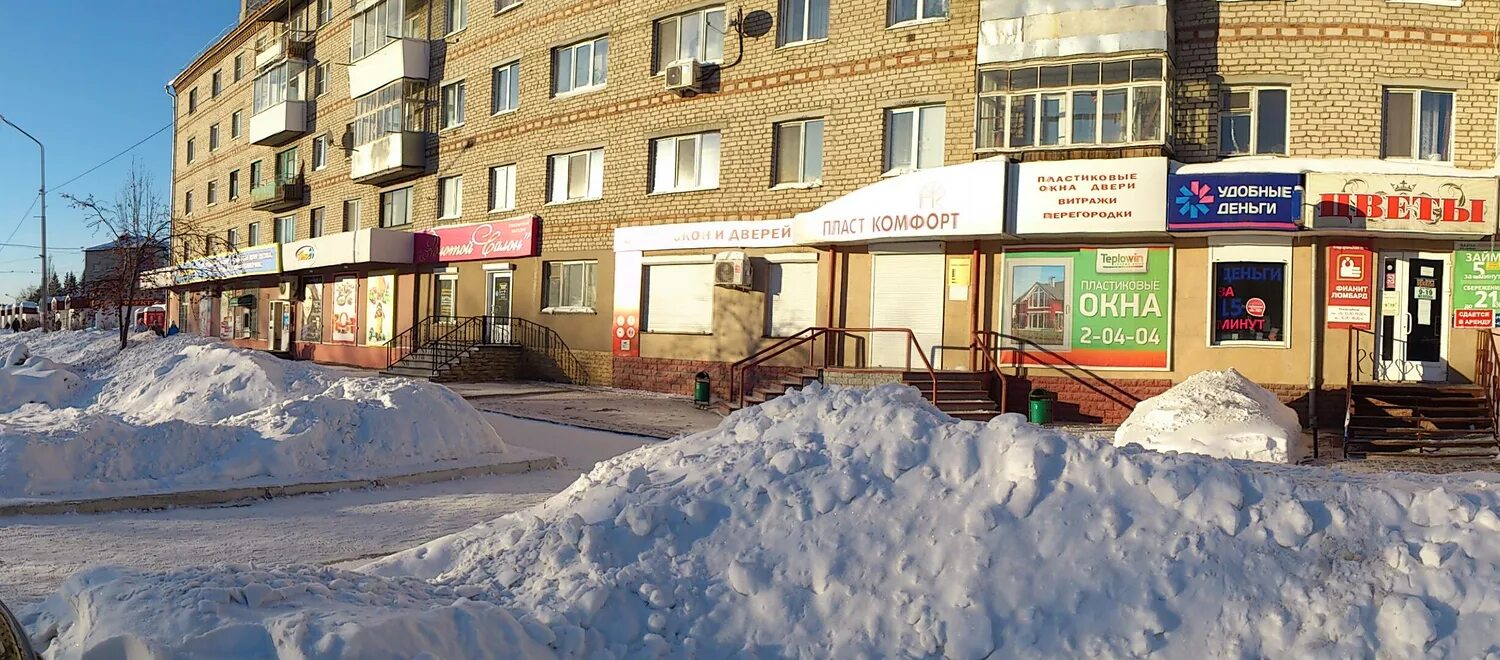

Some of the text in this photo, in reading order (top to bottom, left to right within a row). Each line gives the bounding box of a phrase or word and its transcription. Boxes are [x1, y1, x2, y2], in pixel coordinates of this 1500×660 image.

[1037, 173, 1138, 183] ПЛАСТИКОВЫЕ
[1039, 182, 1136, 192] ОКНА ДВЕРИ
[1217, 185, 1292, 198] УДОБНЫЕ
[1058, 197, 1117, 205] ВИТРАЖИ
[1043, 210, 1132, 219] ПЕРЕГОРОДКИ
[1216, 202, 1277, 214] ДЕНЬГИ
[1318, 193, 1487, 224] ЦВЕТЫ
[823, 212, 960, 236] ПЛАСТ КОМФОРТ
[715, 229, 724, 240] И
[728, 224, 792, 241] ДВЕРЕЙ
[1100, 252, 1144, 266] Teplowin
[1223, 266, 1283, 283] ДЕНЬГИ
[1473, 261, 1486, 276] 5
[1081, 280, 1160, 291] ПЛАСТИКОВЫЕ
[1335, 285, 1368, 293] ФИАНИТ
[1331, 292, 1368, 300] ЛОМБАРД
[1079, 293, 1162, 317] ОКНА
[1080, 327, 1160, 345] 2-04-04
